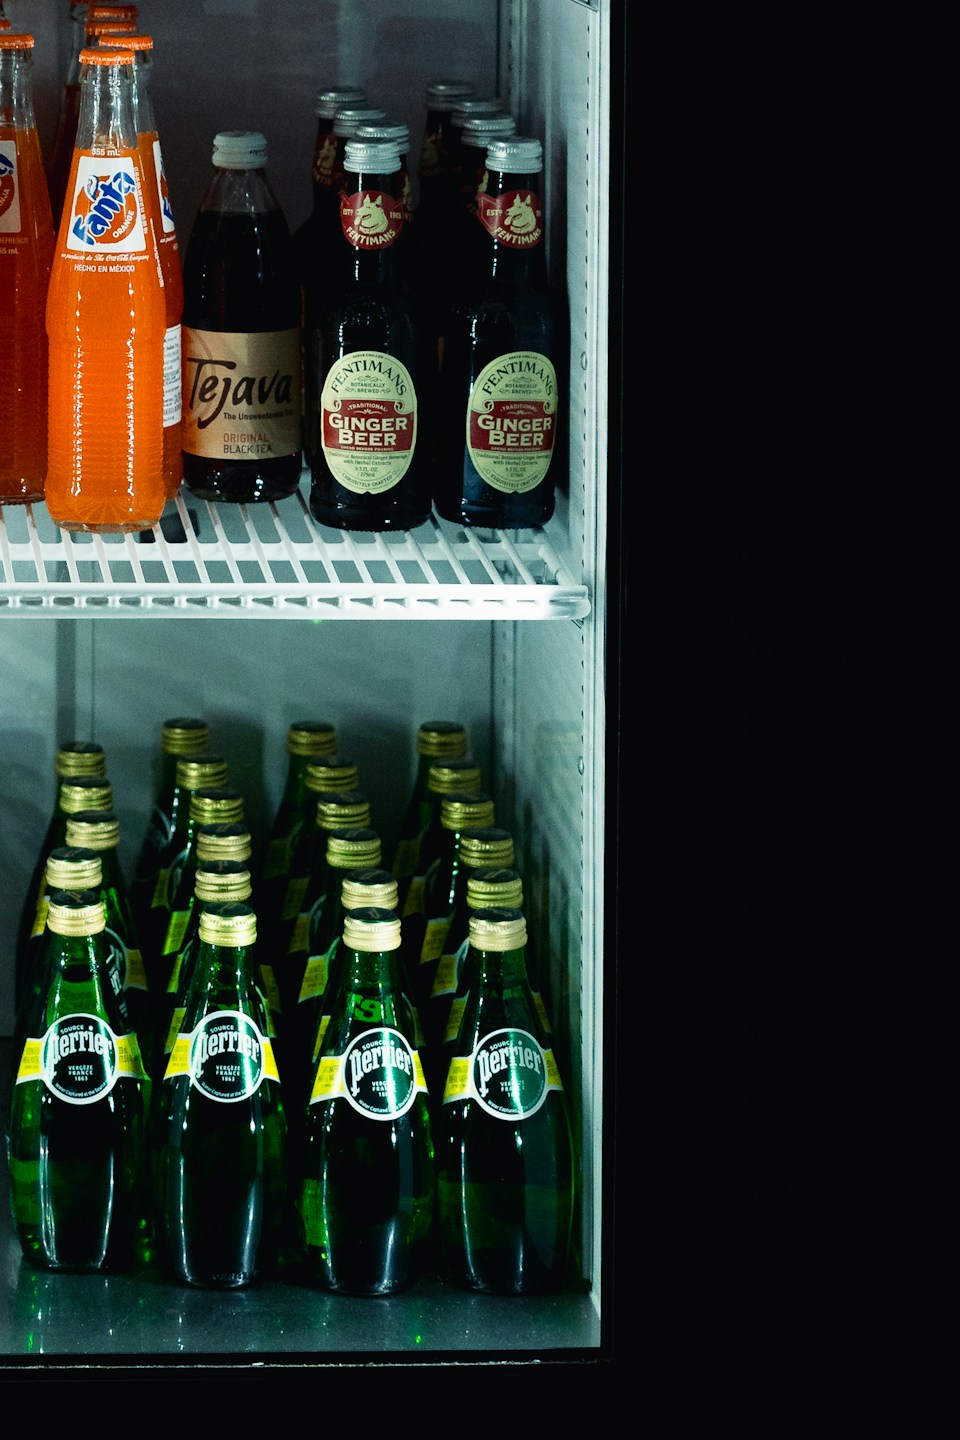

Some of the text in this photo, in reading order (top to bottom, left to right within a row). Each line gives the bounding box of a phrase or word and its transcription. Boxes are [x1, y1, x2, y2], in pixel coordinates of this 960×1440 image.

[73, 171, 136, 246] Fanta
[112, 209, 135, 238] ORANGE
[346, 226, 396, 246] FENTIMANS
[494, 226, 542, 245] FENTIMANS
[74, 263, 135, 272] HECHO EN MÉXICO
[331, 360, 407, 396] FENTIMANS
[482, 361, 554, 397] FENTIMANS
[187, 357, 293, 430] Tejava
[349, 402, 387, 412] TRADITIONAL
[223, 411, 283, 421] The Unsweetened
[328, 413, 408, 431] GINGER
[477, 415, 552, 432] GINGER
[223, 433, 269, 442] ORIGINAL
[338, 429, 397, 446] BEER
[488, 429, 544, 446] BEER
[223, 444, 272, 454] BLACK TEA
[342, 472, 393, 487] EXQUISITELY CRAFTED
[60, 1024, 85, 1035] SOURCE
[209, 1024, 234, 1034] SOURCE
